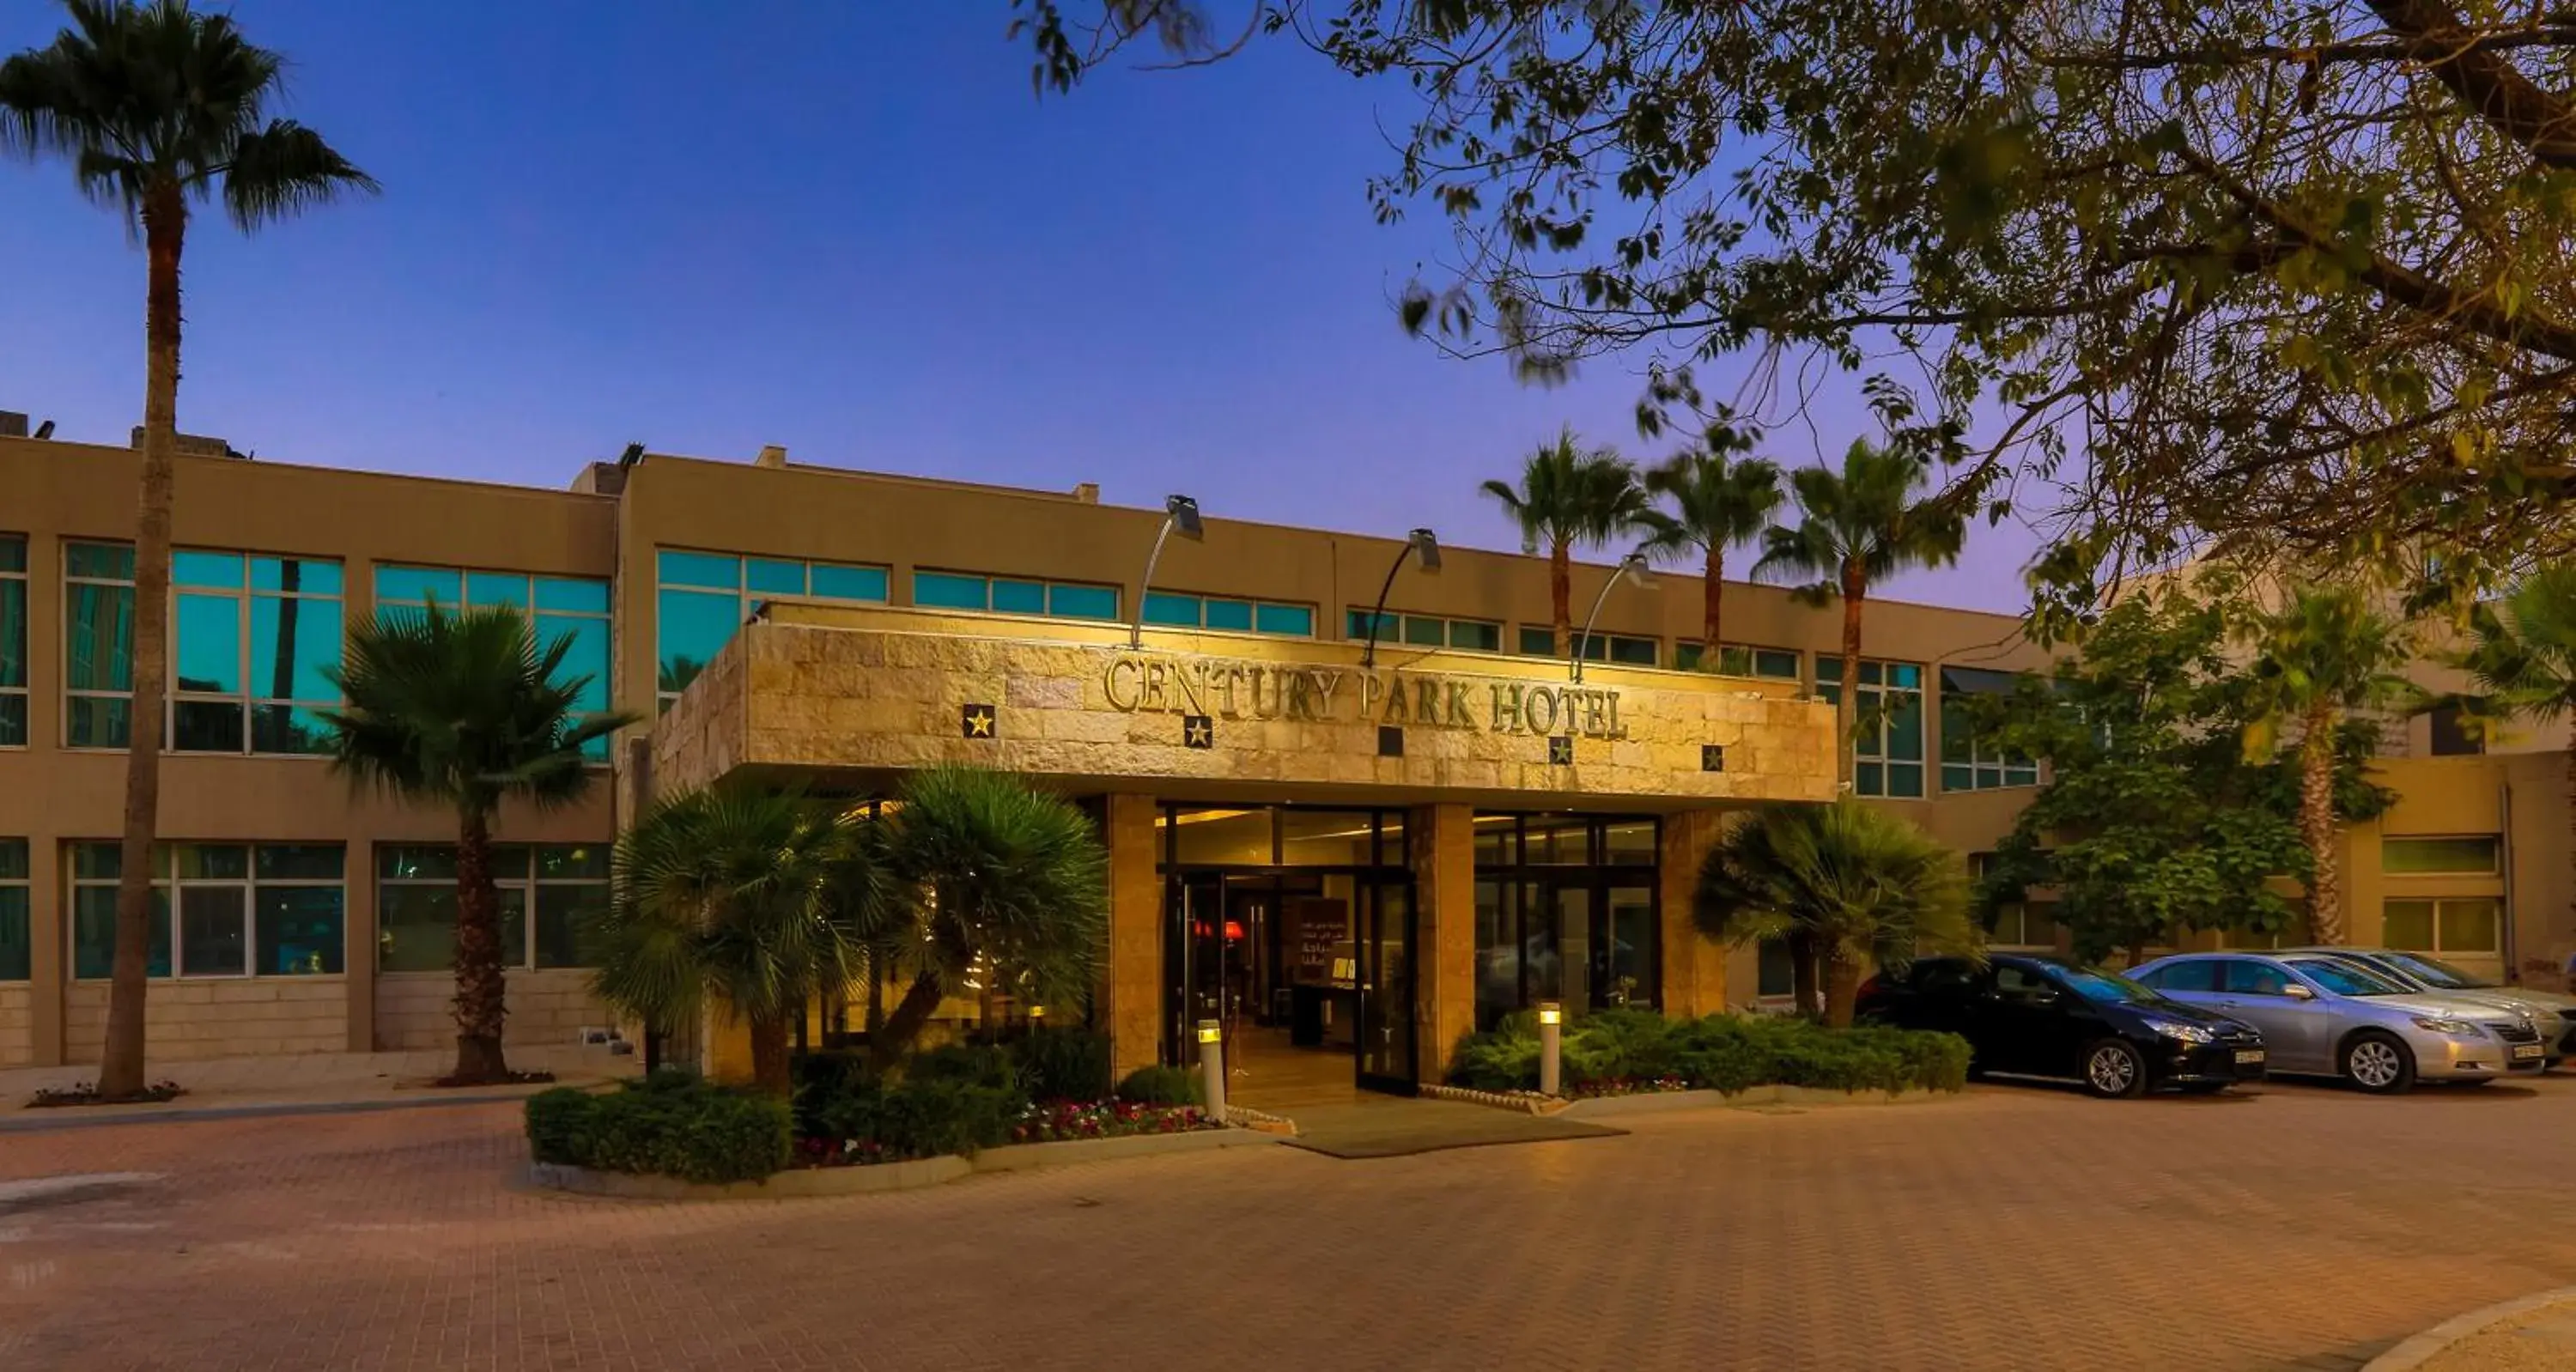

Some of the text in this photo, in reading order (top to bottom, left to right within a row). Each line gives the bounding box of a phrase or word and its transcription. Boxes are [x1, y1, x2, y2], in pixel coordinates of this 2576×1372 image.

[1104, 658, 1629, 740] CENTURY PARK HOTEL
